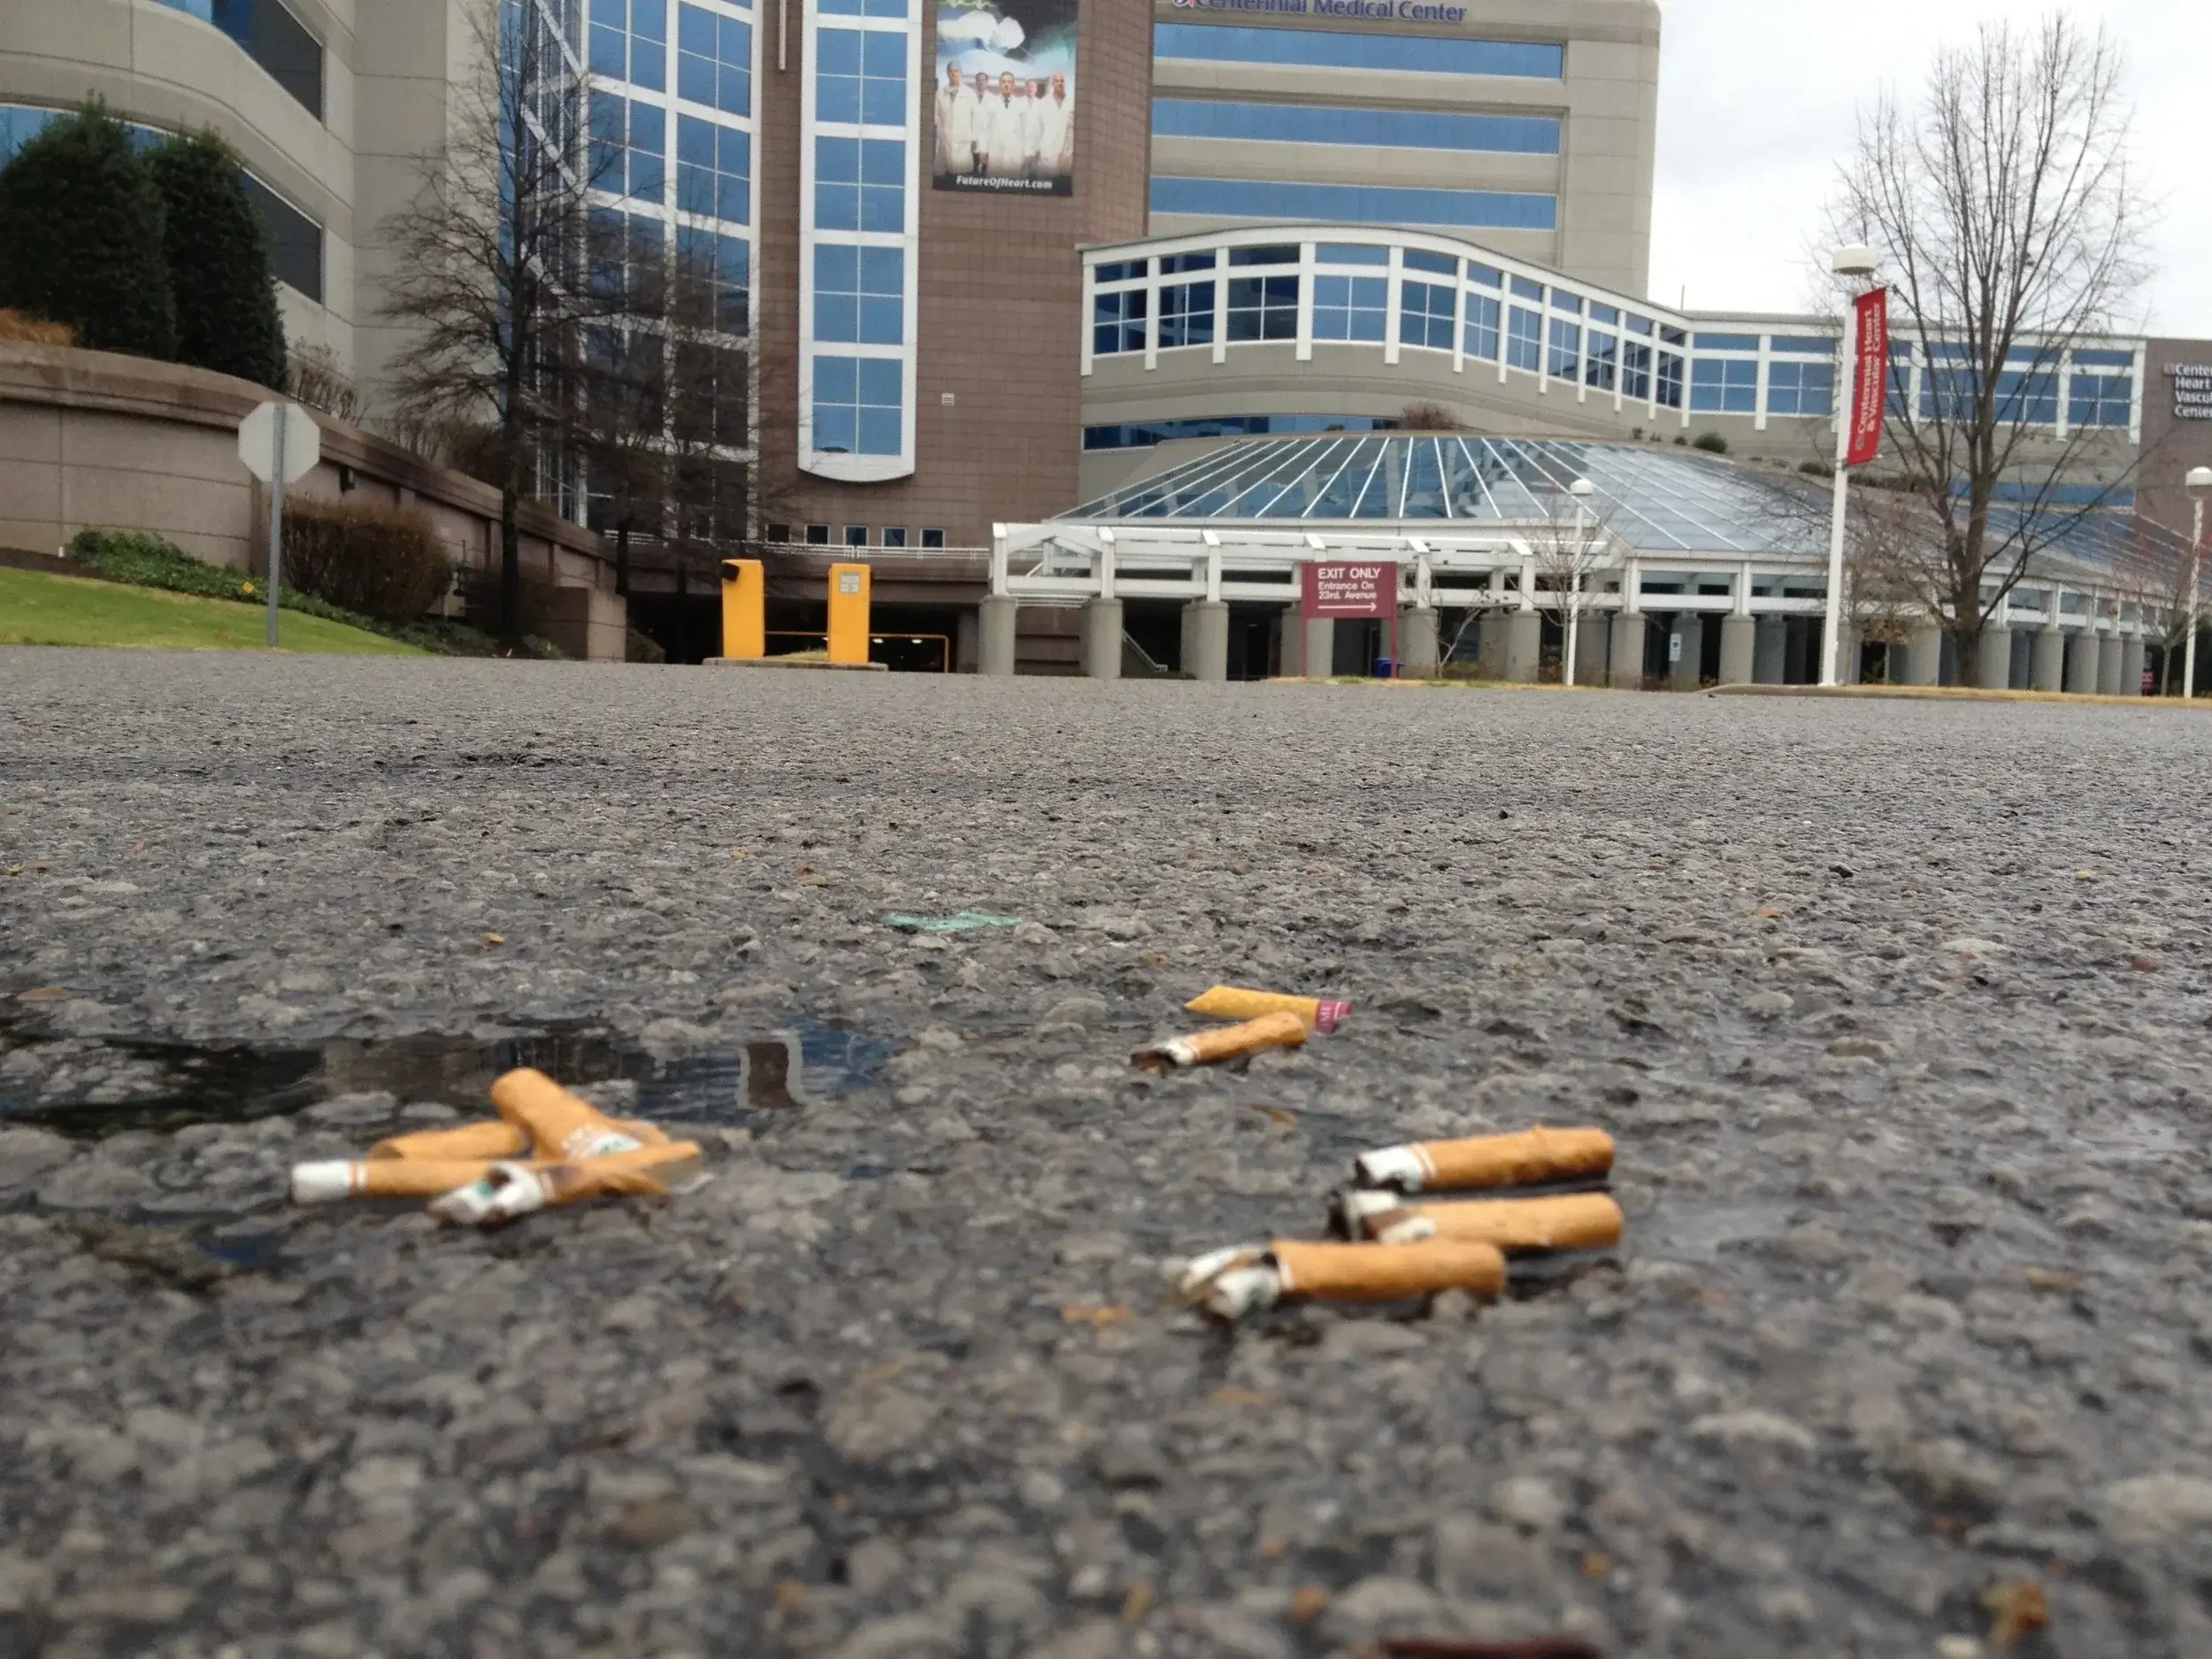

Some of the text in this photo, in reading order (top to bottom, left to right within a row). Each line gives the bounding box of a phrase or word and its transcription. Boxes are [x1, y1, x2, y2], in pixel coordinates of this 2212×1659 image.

[1314, 0, 1394, 18] Medical
[1399, 1, 1467, 22] Center
[956, 175, 1053, 188] FutureOfHeart.com
[1863, 308, 1872, 353] Heart
[1872, 302, 1881, 352] Center
[1317, 568, 1380, 579] EXIT ONLY
[1318, 581, 1374, 590] Entrance On
[1319, 591, 1377, 600] 23rd. Avenue
